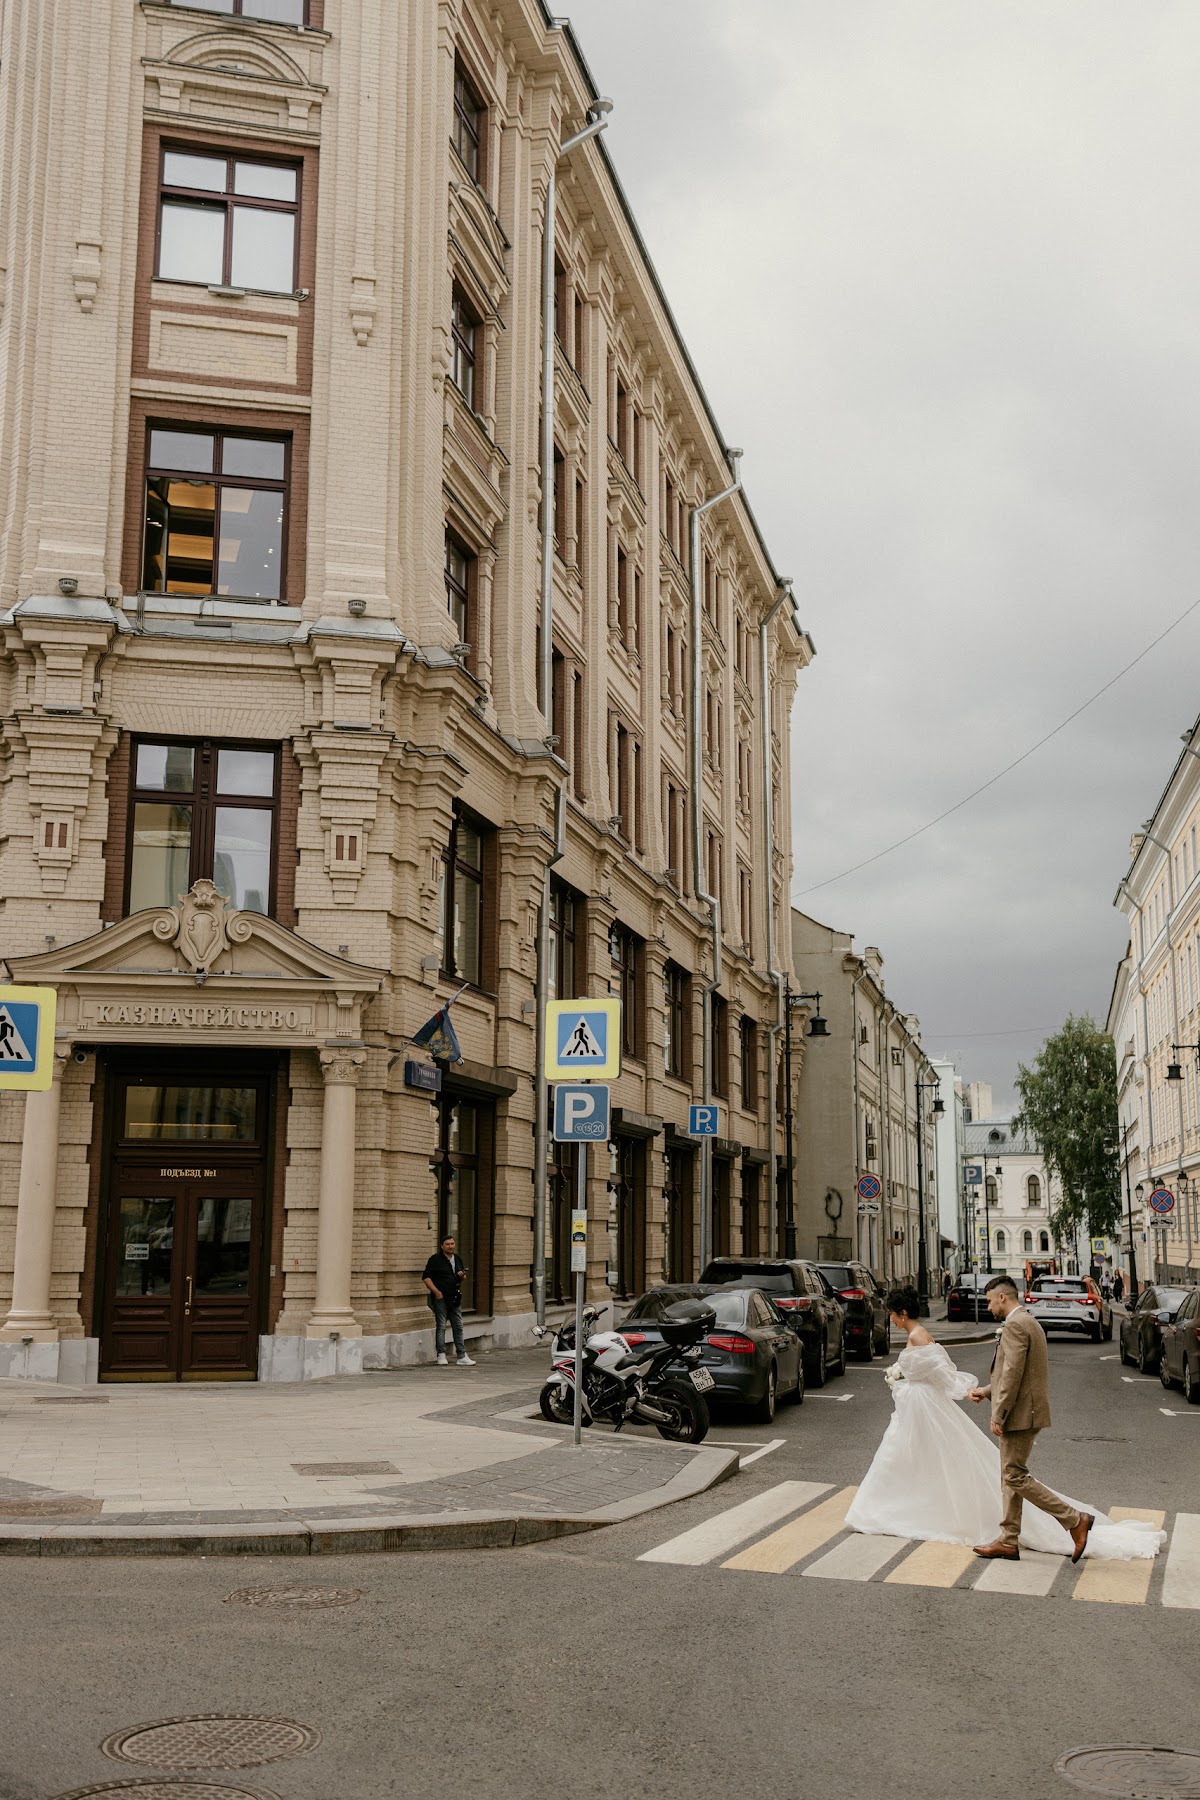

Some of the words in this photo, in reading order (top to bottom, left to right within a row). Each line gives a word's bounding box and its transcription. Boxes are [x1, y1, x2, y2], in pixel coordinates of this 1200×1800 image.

[97, 1005, 299, 1029] КАЗНАЧЕЙСТВО
[564, 1092, 595, 1133] P
[696, 1108, 711, 1130] P
[593, 1124, 603, 1133] 20
[160, 1168, 201, 1178] ПОДЪЕЗД
[203, 1169, 217, 1177] №1
[965, 1167, 977, 1182] P
